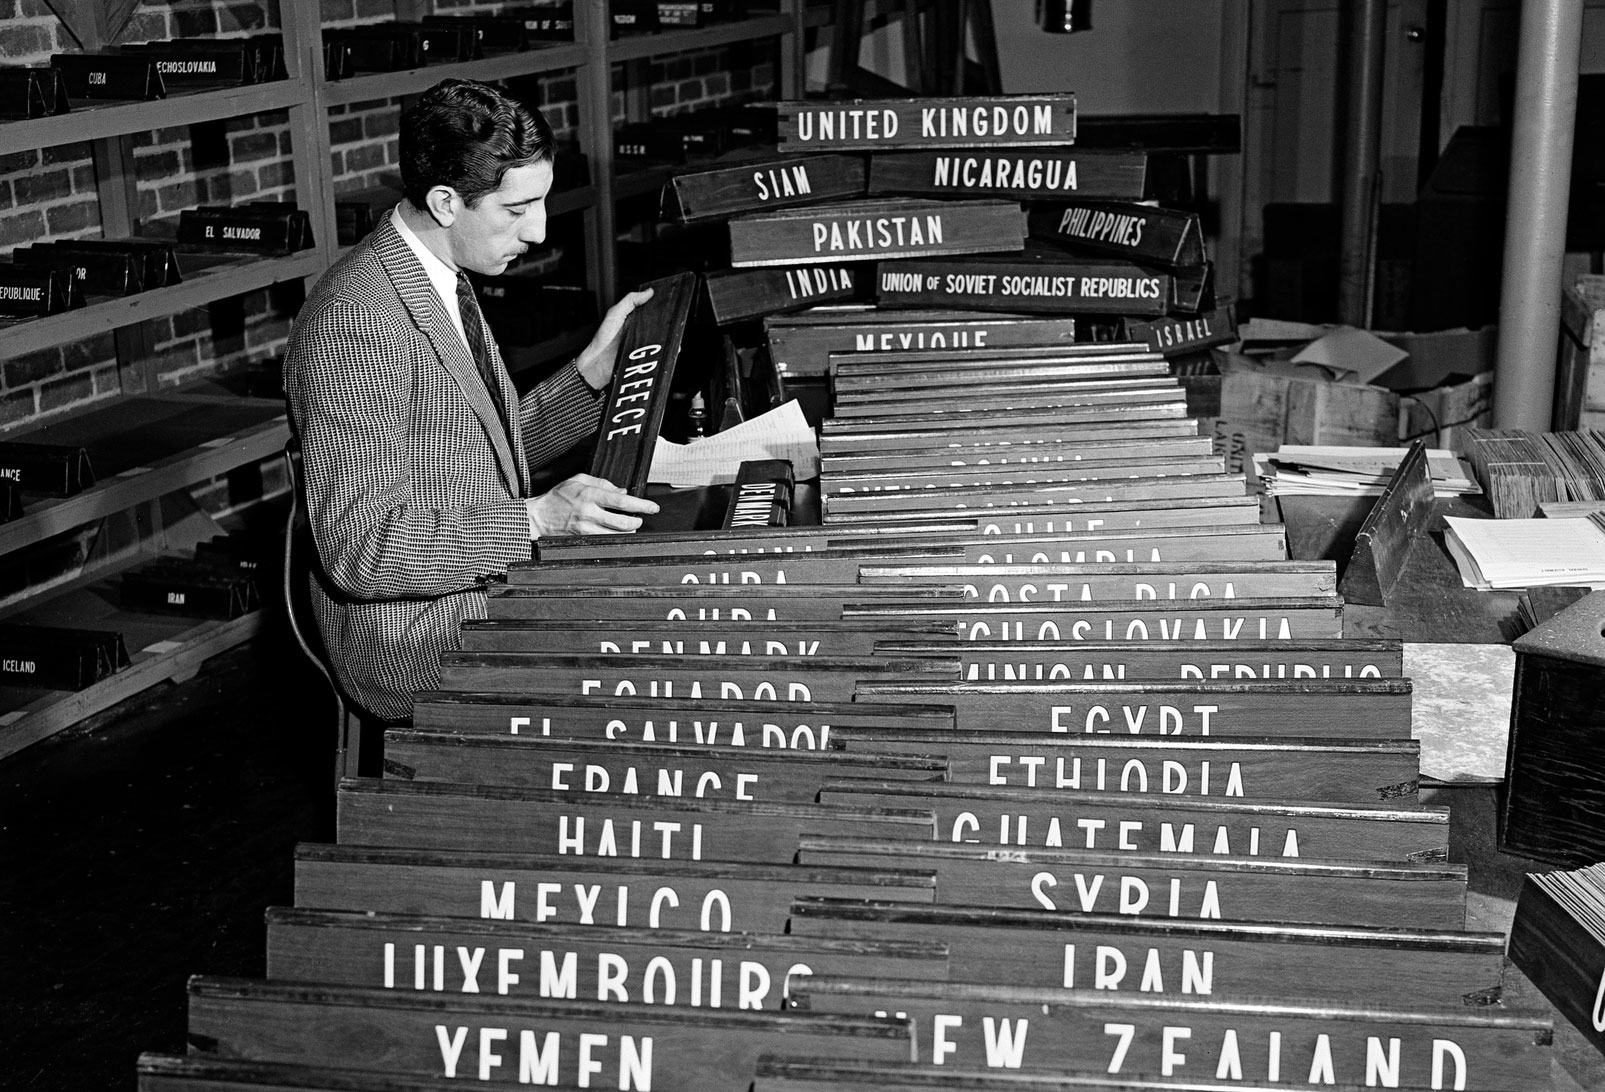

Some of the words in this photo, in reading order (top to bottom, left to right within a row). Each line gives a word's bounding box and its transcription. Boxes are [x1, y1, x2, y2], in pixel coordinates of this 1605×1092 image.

[88, 72, 106, 84] CUBA
[798, 109, 899, 141] UNITED
[922, 105, 1052, 138] KINGDOM
[753, 165, 811, 201] SIAM
[934, 157, 1078, 190] NICARAGUA
[205, 226, 214, 238] EL
[223, 227, 261, 240] SALVADOR
[812, 215, 943, 252] PAKISTAN
[1058, 208, 1146, 247] PHILIPPINES
[785, 268, 852, 299] INDIA
[882, 272, 923, 292] UNION
[926, 277, 942, 290] OF
[945, 274, 997, 295] SOVIET
[1001, 276, 1076, 297] SOCIALIST
[1080, 277, 1160, 299] REPUBLICS
[1156, 318, 1212, 348] ISRAEL
[606, 343, 662, 441] GREECE
[730, 482, 777, 527] DENMARK
[168, 592, 185, 605] IRAN
[3, 659, 36, 674] ICELAND
[558, 815, 703, 861] HAITI
[480, 880, 732, 933] MEXICO
[1063, 944, 1215, 996] IRAN
[435, 1024, 654, 1092] YEMEN
